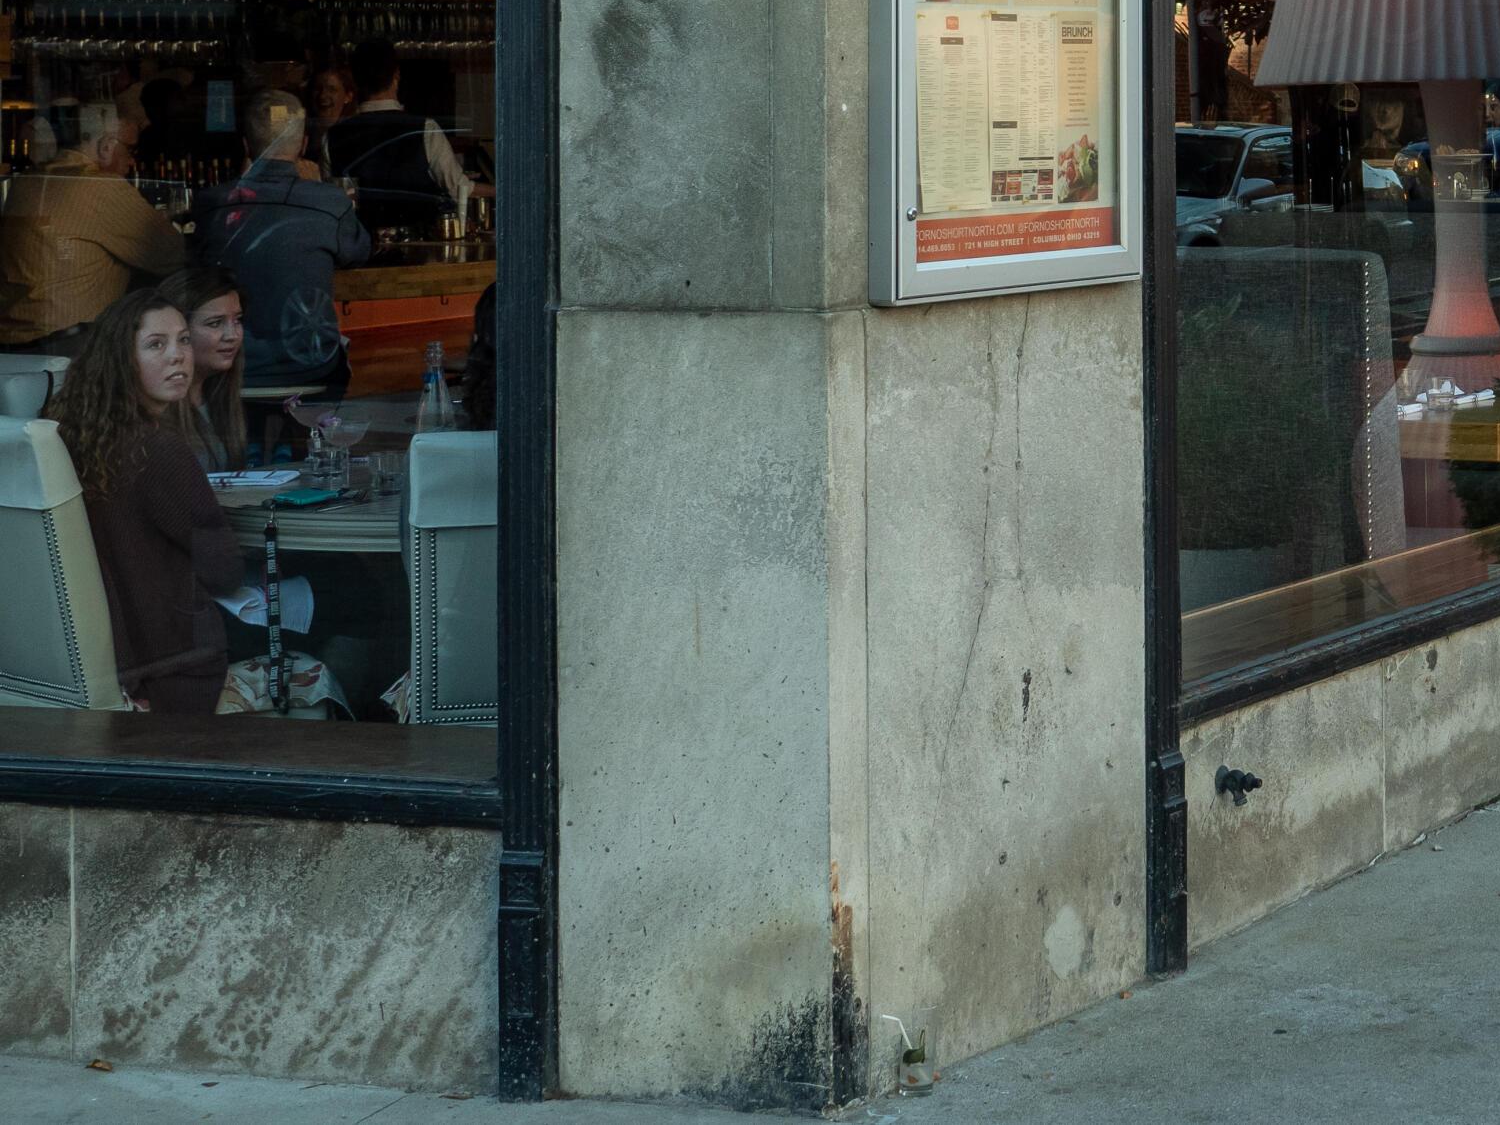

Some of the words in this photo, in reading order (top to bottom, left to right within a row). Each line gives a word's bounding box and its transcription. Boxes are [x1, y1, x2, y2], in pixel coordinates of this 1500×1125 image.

[1061, 26, 1093, 38] BRUNCH
[916, 223, 1015, 241] ORNOSHORTNORTH.COM
[983, 239, 999, 248] HIGH
[1000, 237, 1024, 247] STREET
[1033, 234, 1066, 243] COLUMBUS
[1066, 232, 1082, 241] OHIO
